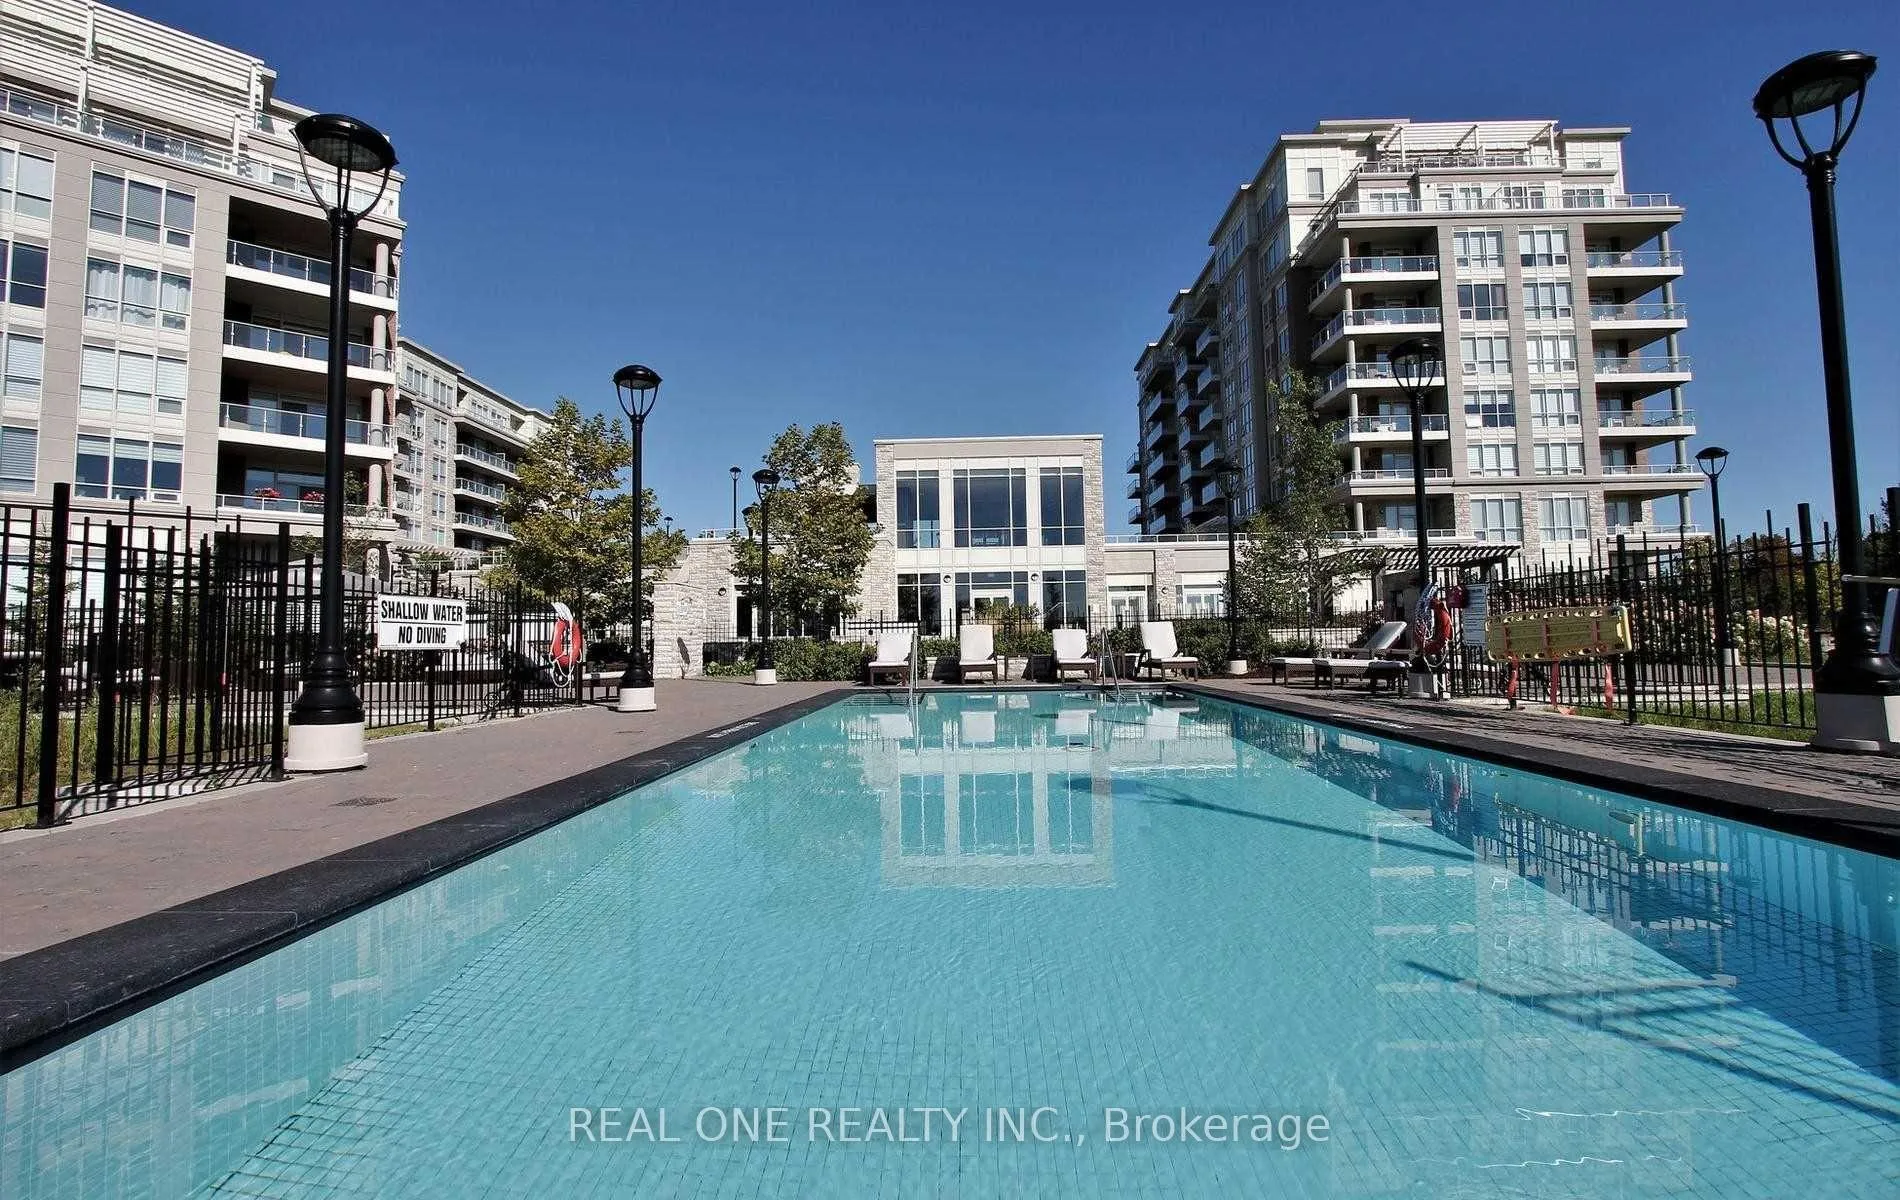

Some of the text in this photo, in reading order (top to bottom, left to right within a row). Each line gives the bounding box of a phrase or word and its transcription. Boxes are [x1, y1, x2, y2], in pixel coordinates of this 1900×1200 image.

[381, 600, 463, 622] SHALLOW WATER
[398, 626, 447, 644] NO DIVING
